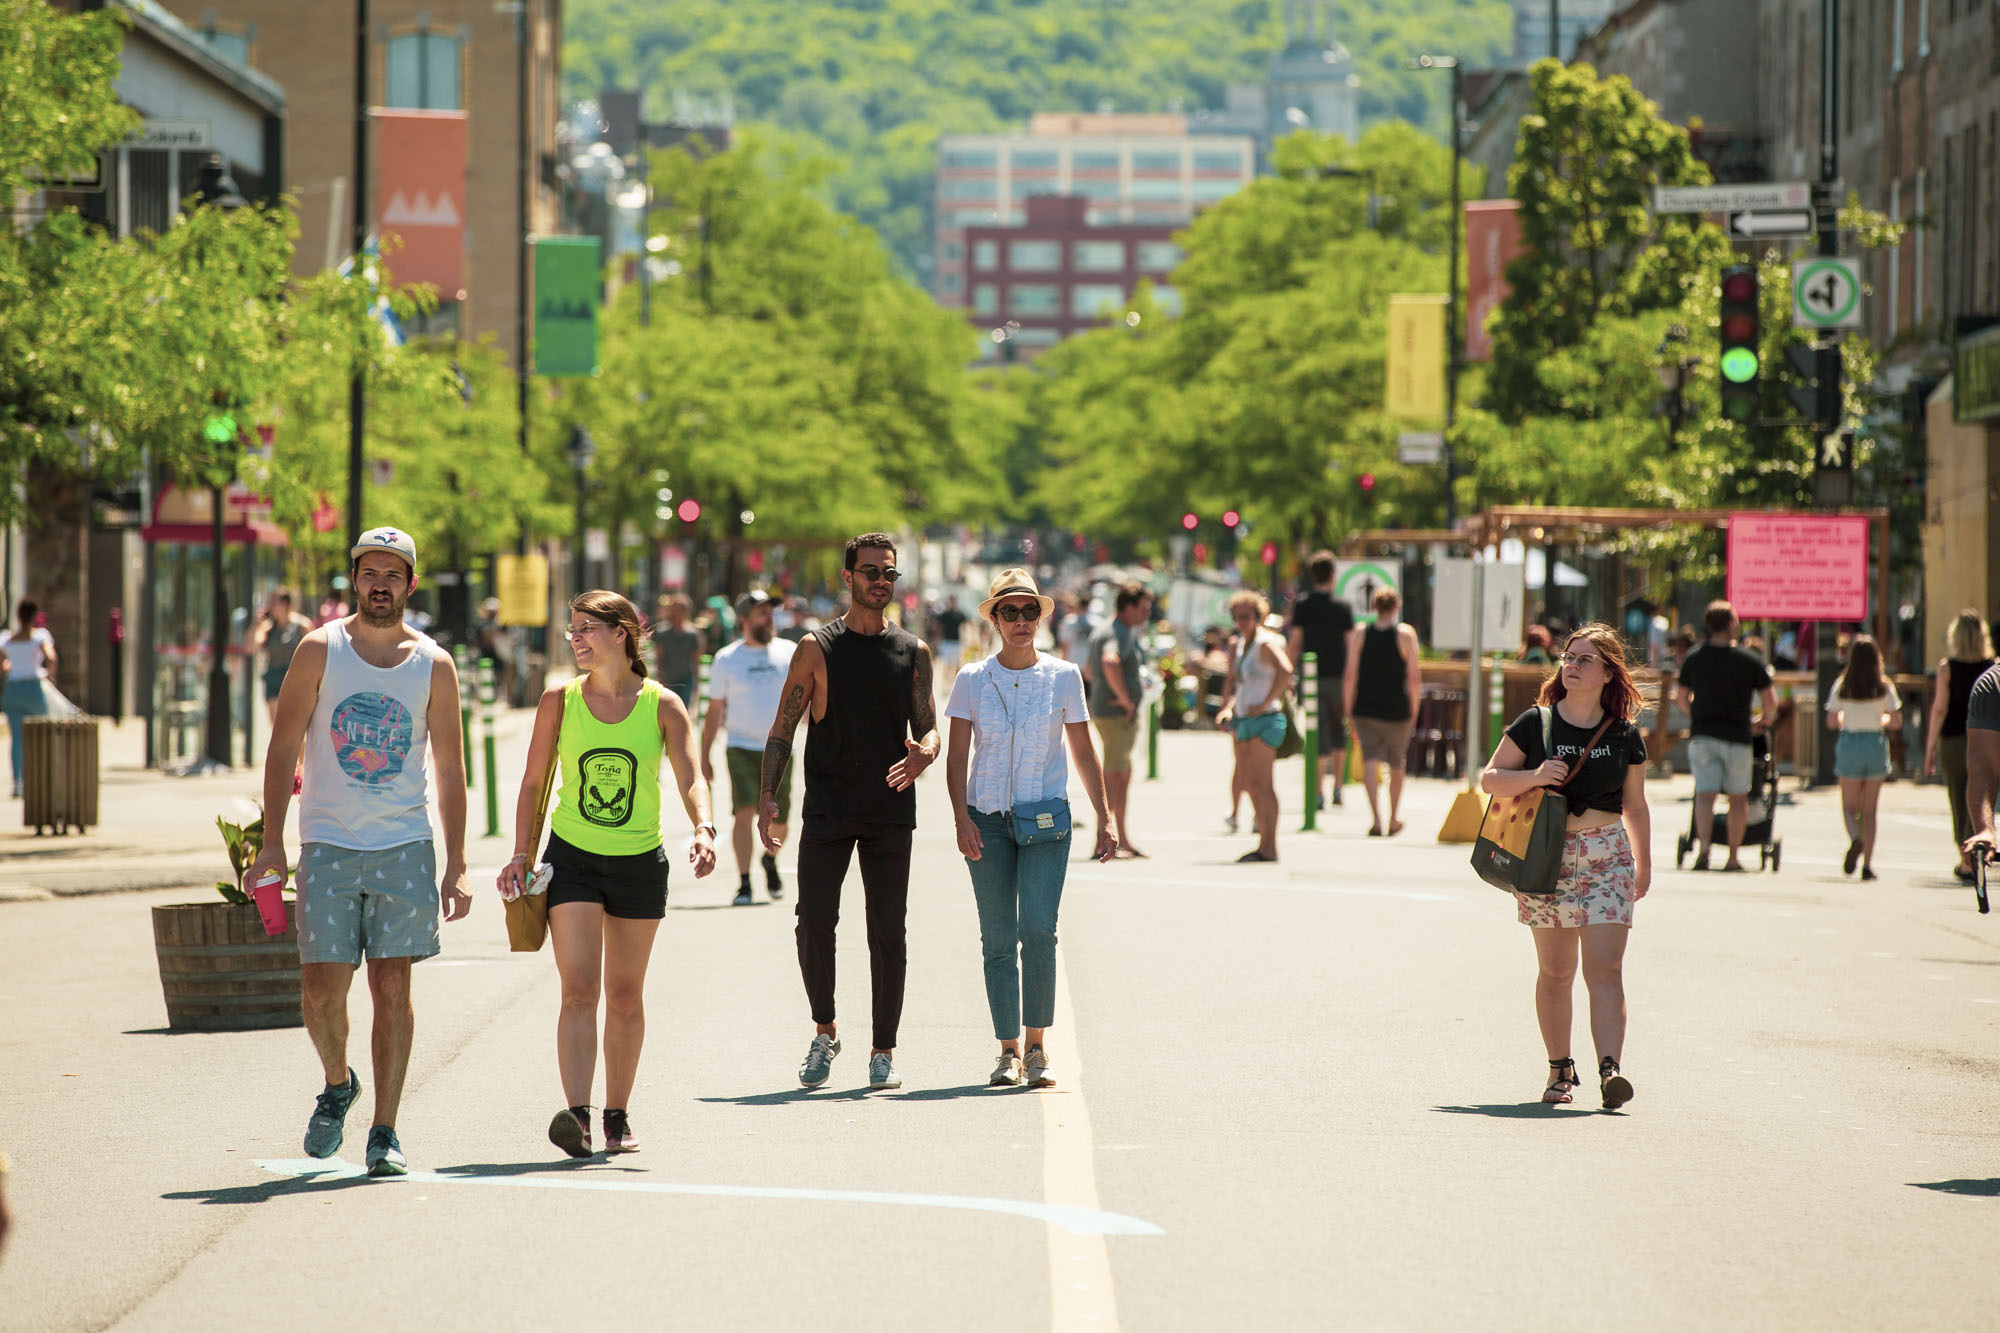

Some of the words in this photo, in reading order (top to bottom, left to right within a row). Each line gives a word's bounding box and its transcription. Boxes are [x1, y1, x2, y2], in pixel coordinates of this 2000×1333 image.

[346, 720, 399, 747] NEFF
[1556, 744, 1577, 756] get
[1590, 745, 1611, 758] girl
[594, 763, 621, 774] Toña
